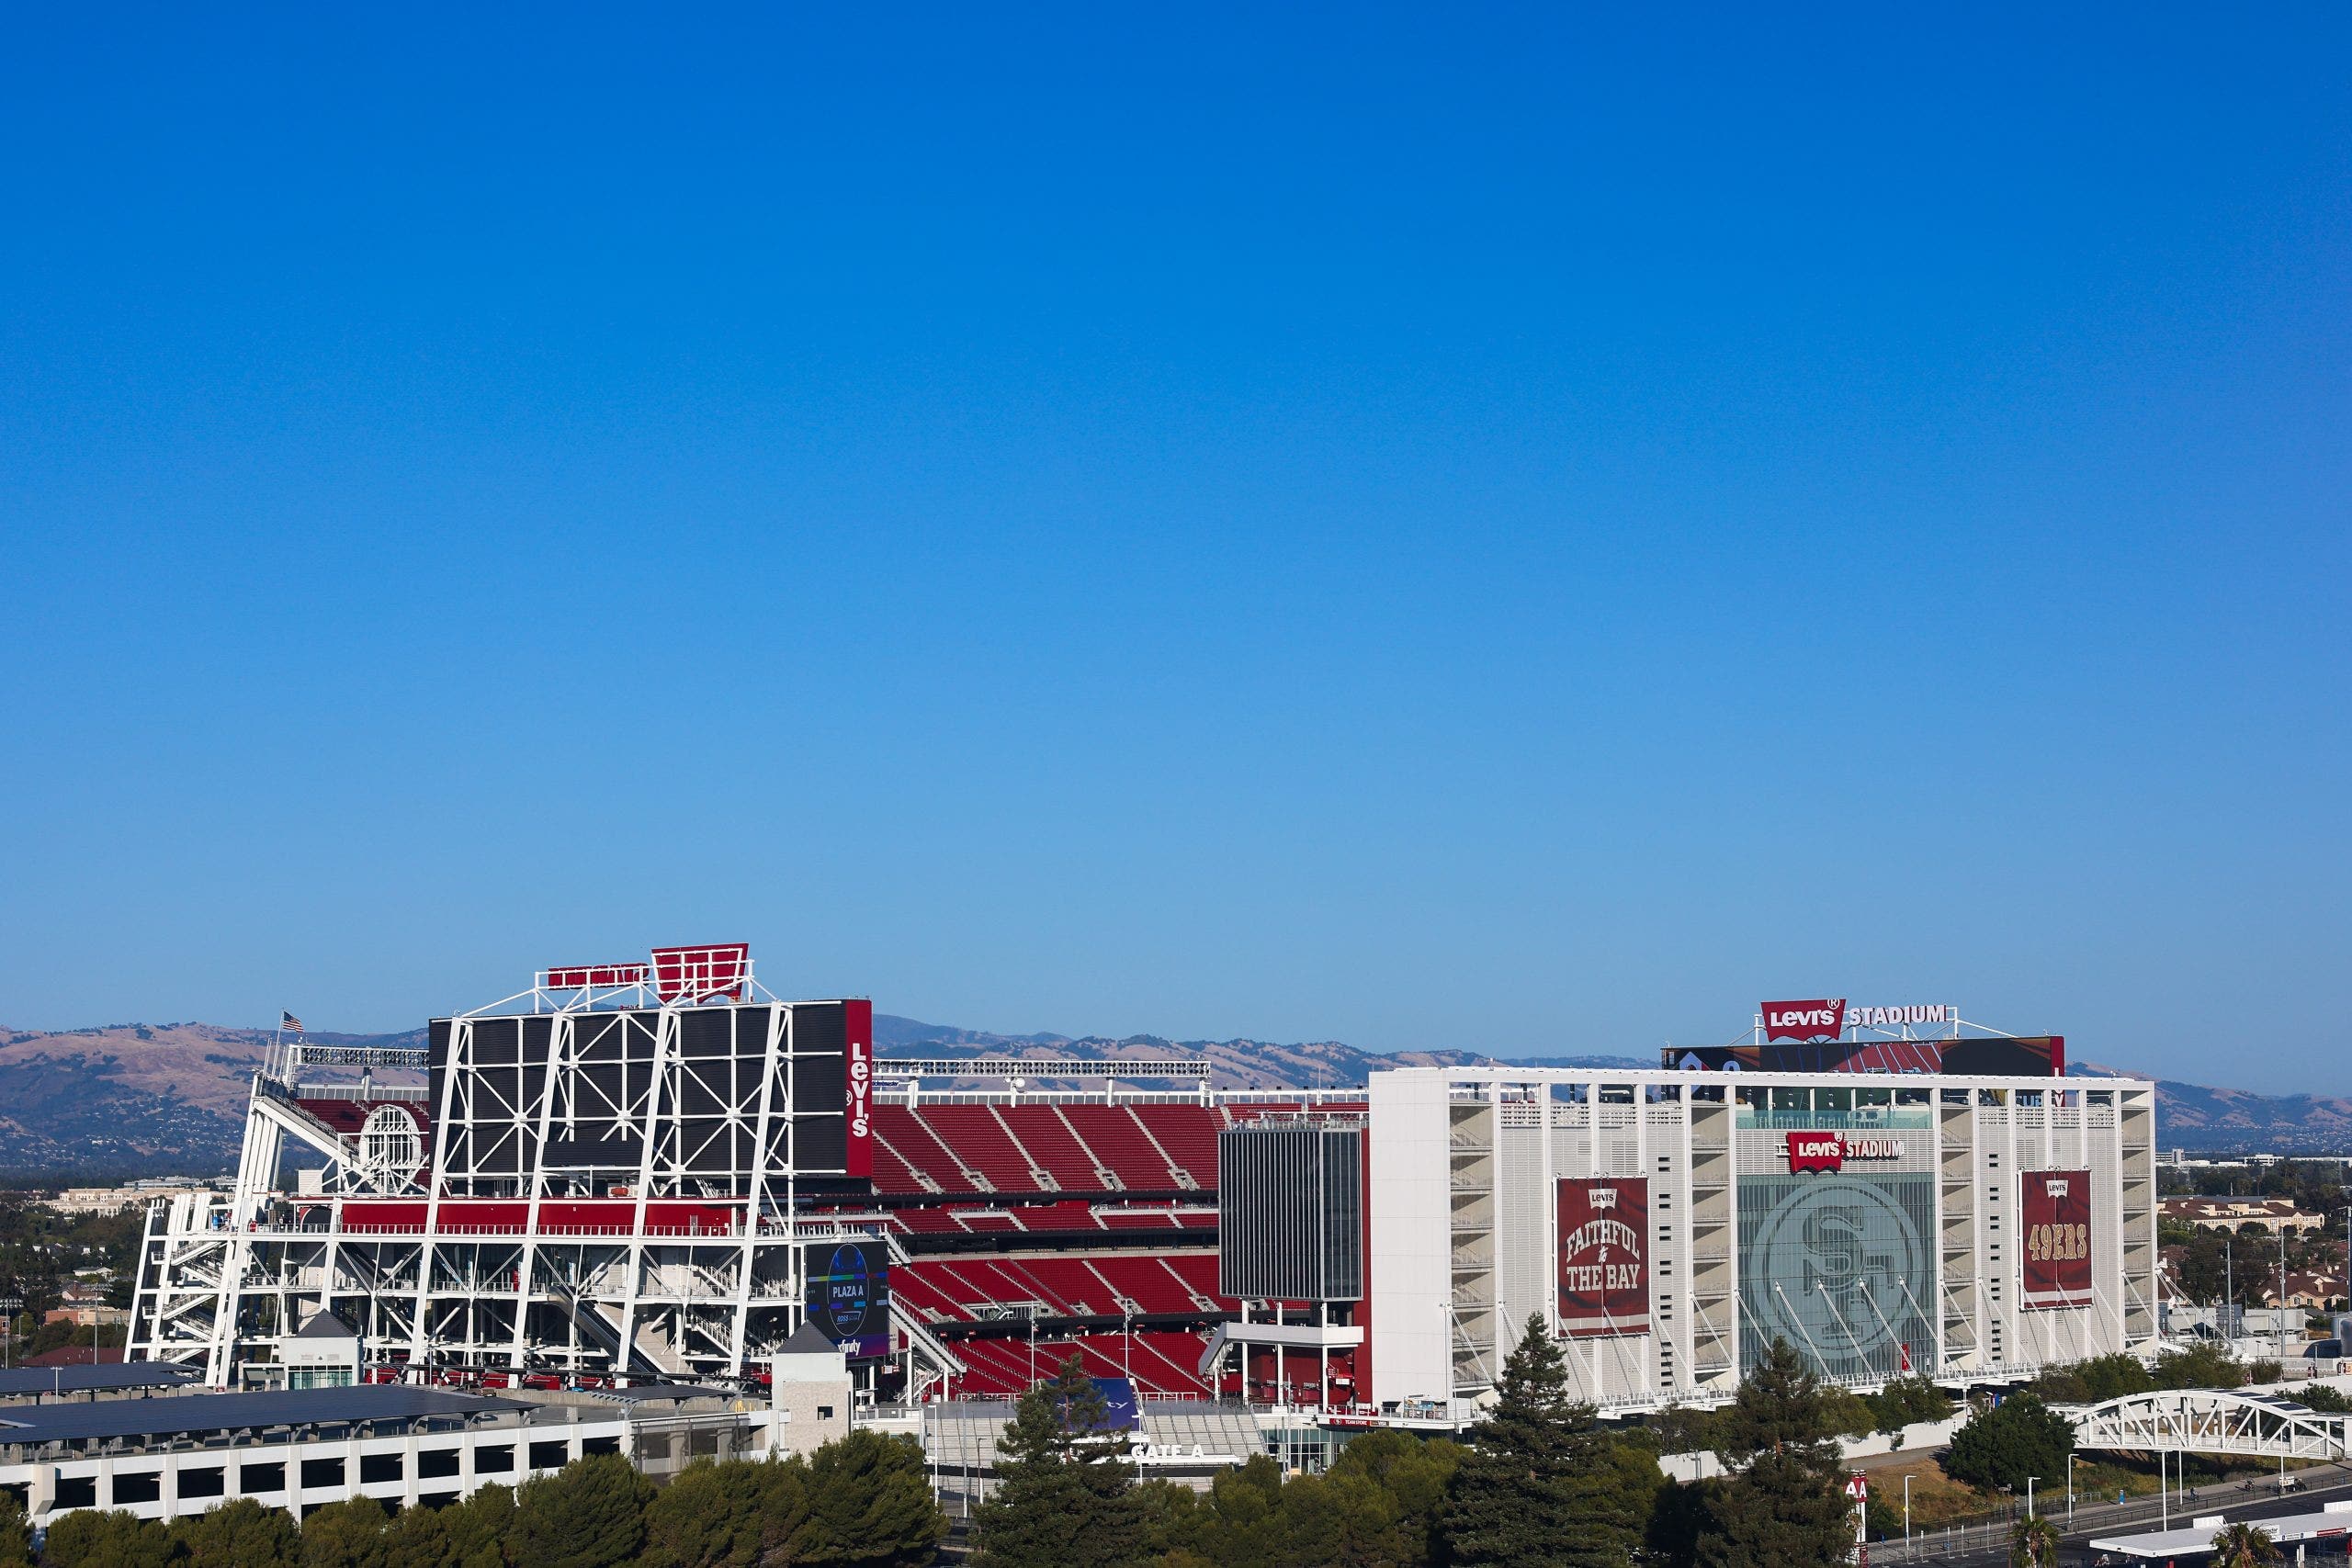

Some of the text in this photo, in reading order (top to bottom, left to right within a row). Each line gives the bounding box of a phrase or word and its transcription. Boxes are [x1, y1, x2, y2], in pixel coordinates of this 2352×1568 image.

[1849, 1004, 1947, 1025] STADIUM
[1846, 1140, 1905, 1158] STADIUM
[1566, 1219, 1640, 1264] FAITHFUL
[2028, 1224, 2087, 1261] 49ERS
[1566, 1263, 1641, 1292] THE BAY
[832, 1285, 864, 1298] PLAZA A
[1131, 1444, 1204, 1461] GATE A
[1860, 1482, 1867, 1498] A
